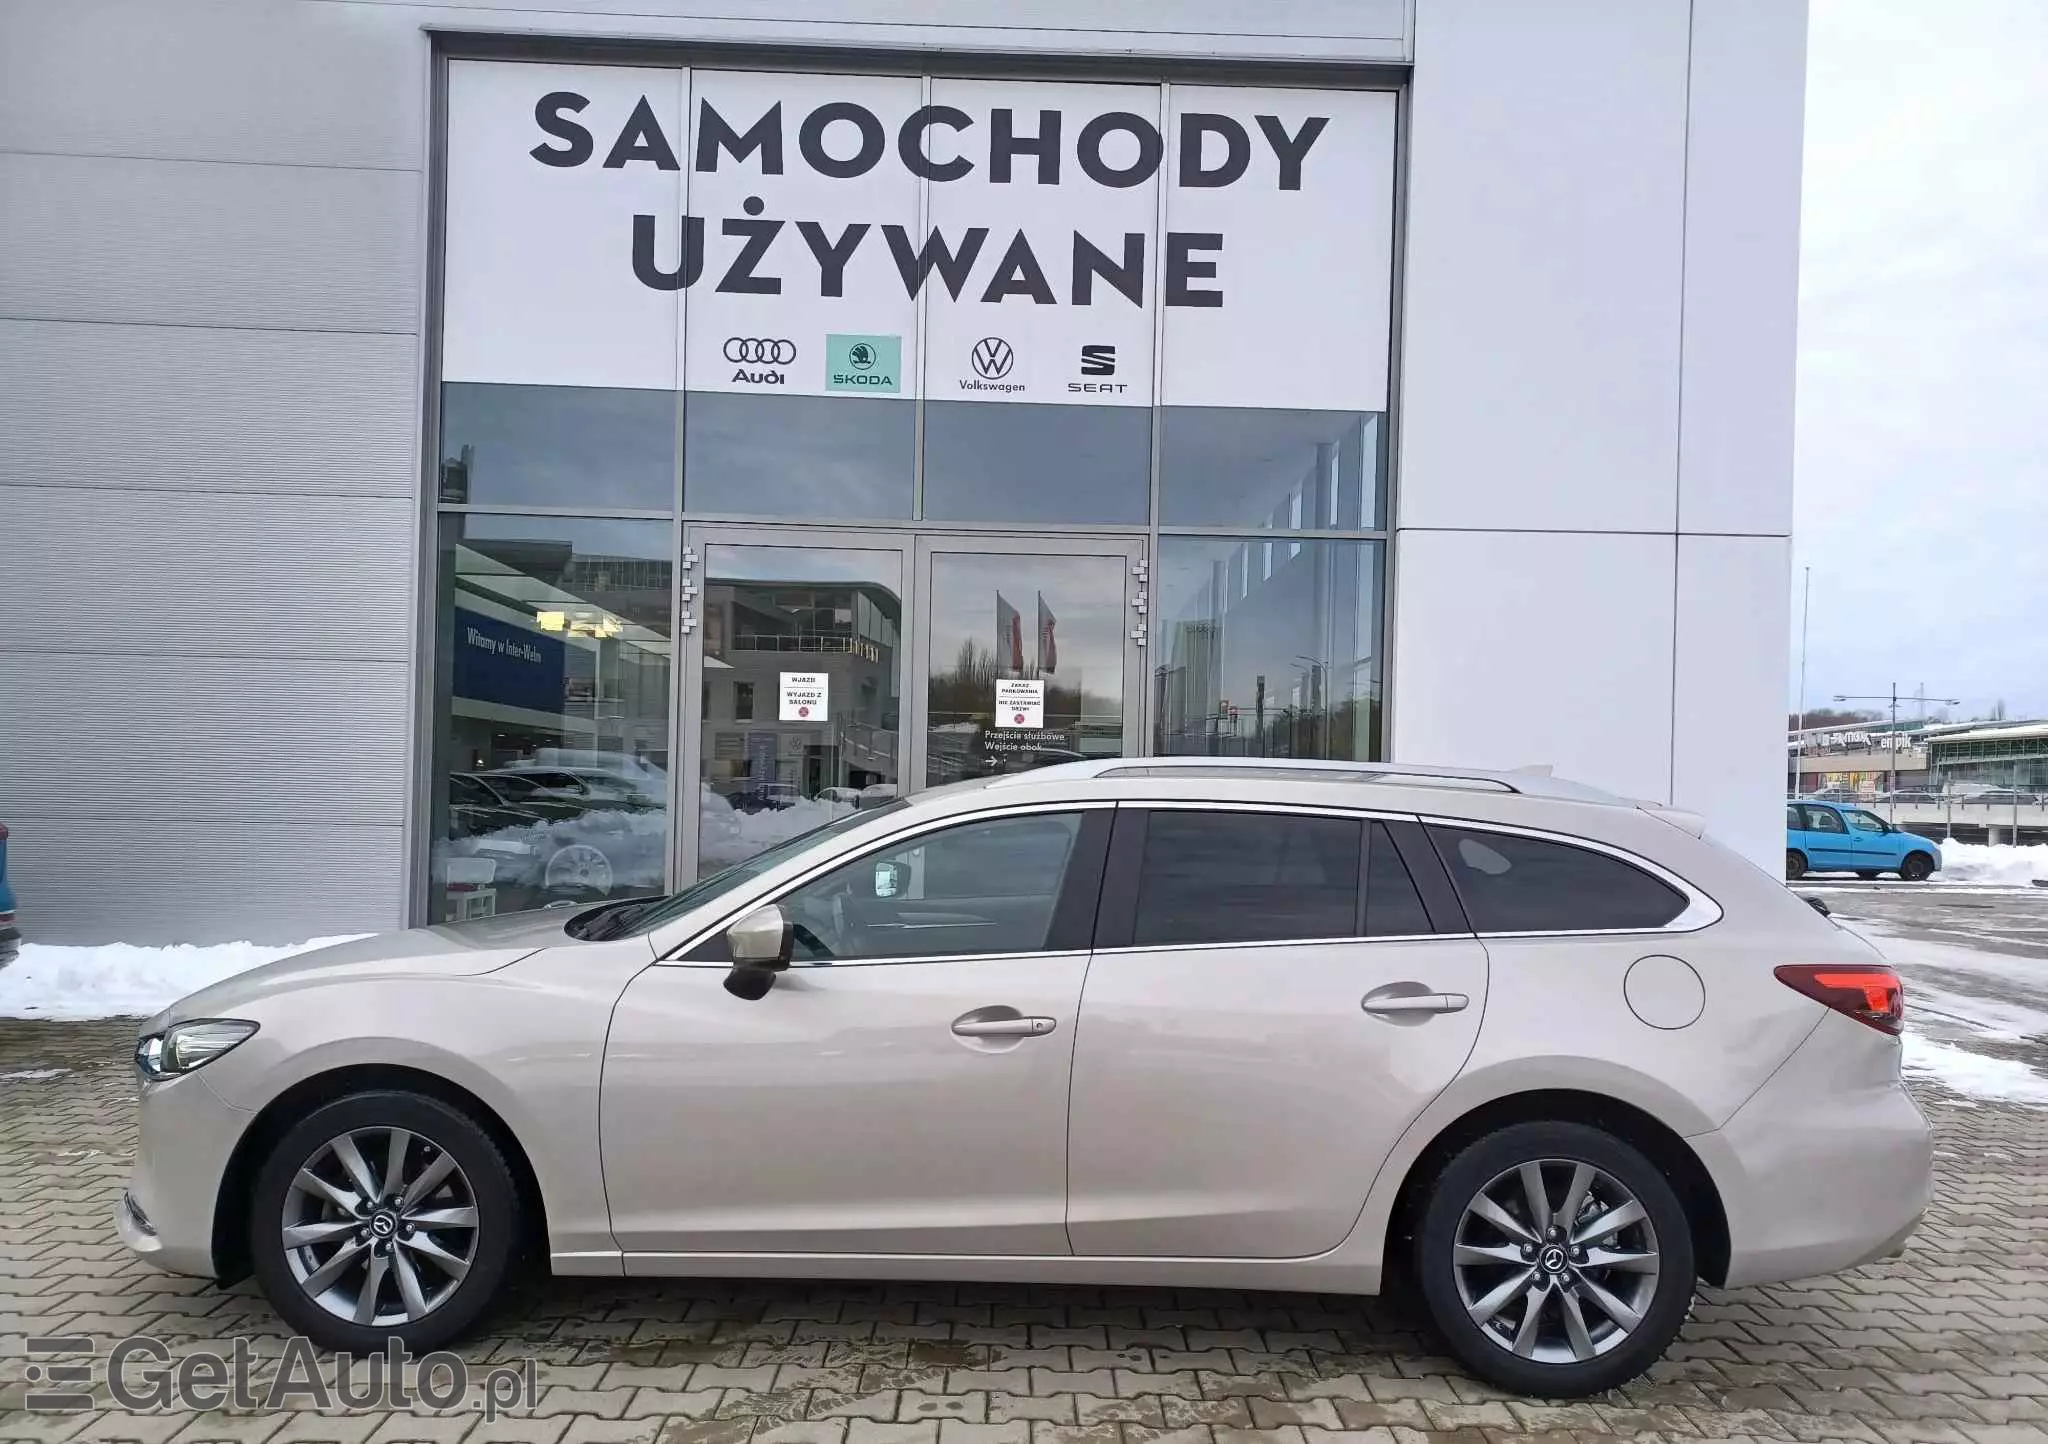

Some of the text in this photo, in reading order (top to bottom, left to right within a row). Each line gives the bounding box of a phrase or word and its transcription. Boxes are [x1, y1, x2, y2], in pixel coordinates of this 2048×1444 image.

[530, 91, 1330, 191] SAMOCHODY
[632, 195, 1225, 308] UŻYWANE
[731, 368, 785, 385] Audi
[959, 379, 1026, 394] Volkswagen
[1067, 382, 1128, 394] SEAT
[984, 730, 1065, 741] Przejście służbowe
[984, 741, 1041, 751] Wejście obok
